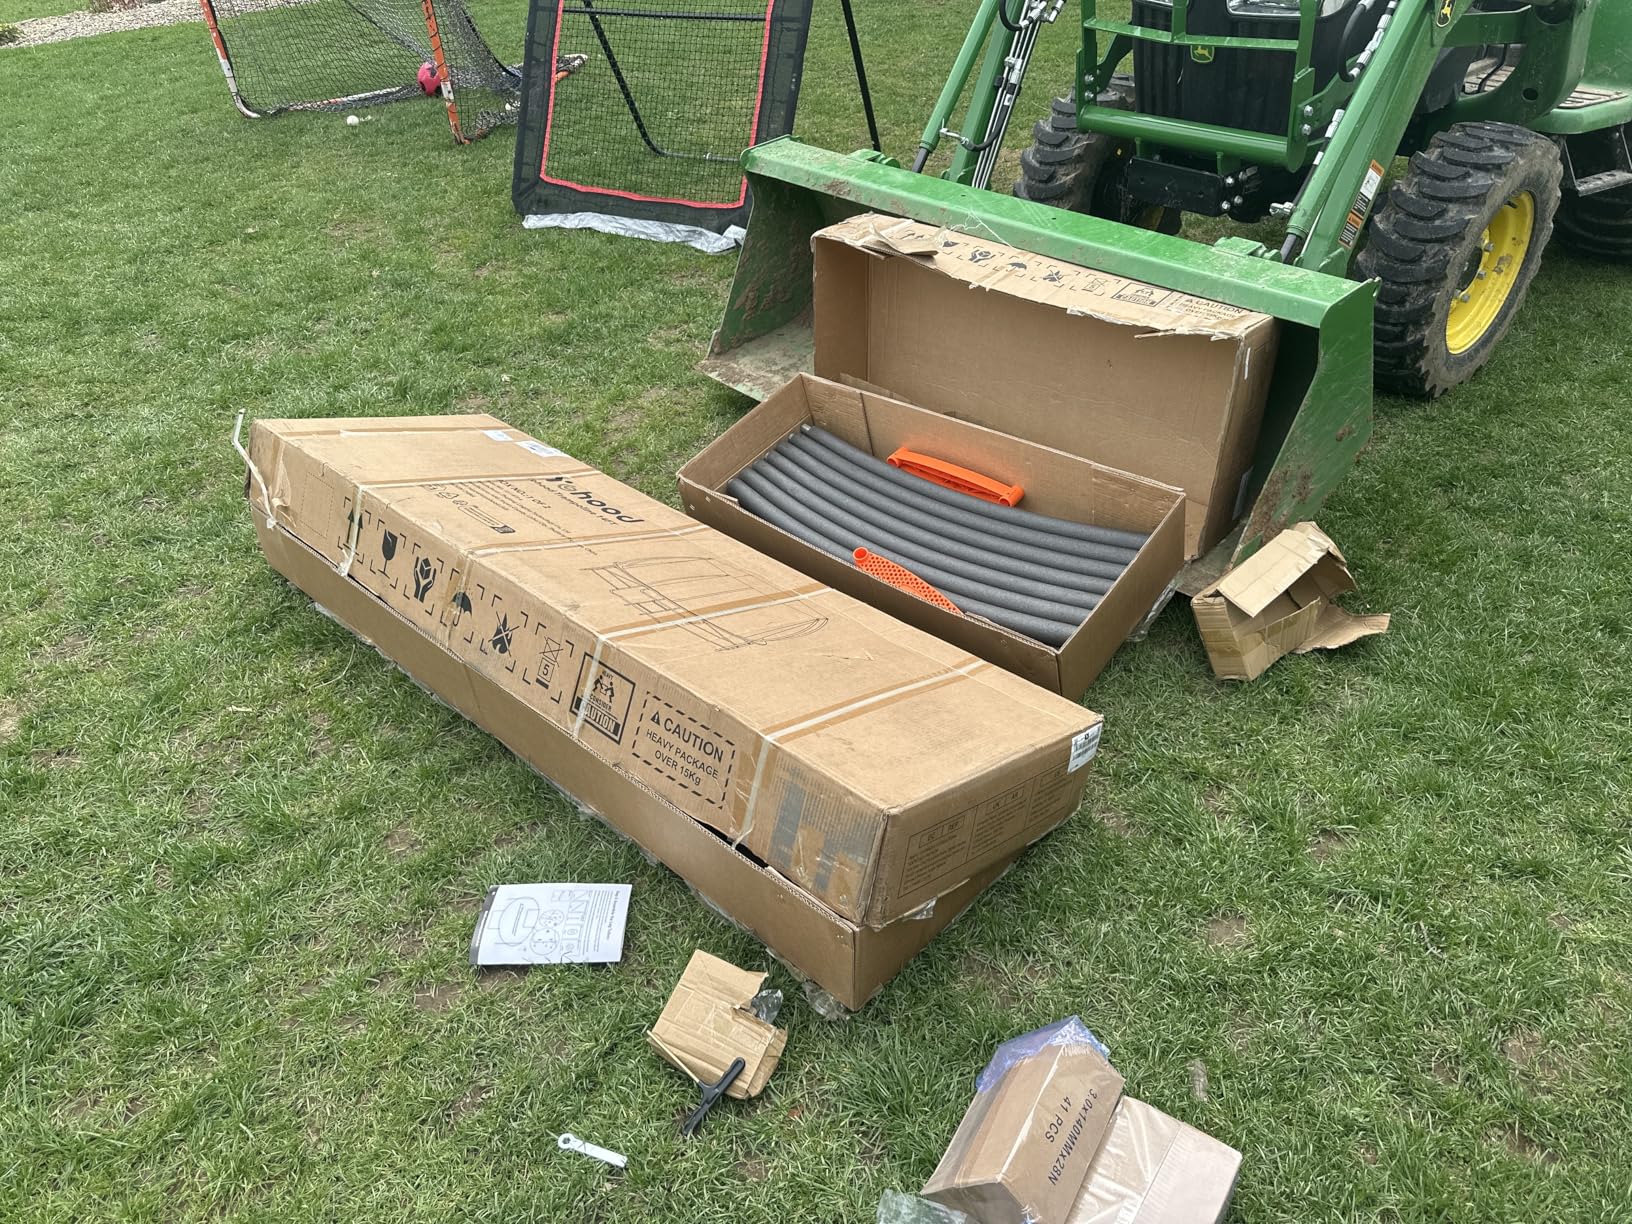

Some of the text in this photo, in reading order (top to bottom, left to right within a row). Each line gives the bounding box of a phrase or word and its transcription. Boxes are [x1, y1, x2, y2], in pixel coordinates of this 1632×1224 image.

[1195, 300, 1244, 313] CAUTION
[555, 491, 597, 515] Trampoline
[542, 664, 549, 676] 5
[584, 701, 616, 733] AUTION
[646, 729, 719, 779] HEAVY PACKAGE
[664, 718, 724, 763] CAUTION
[654, 750, 701, 786] OVER 15Kg
[1045, 1096, 1073, 1143] 41 PCS
[1048, 1088, 1098, 1186] 3.0x140MMx28N
